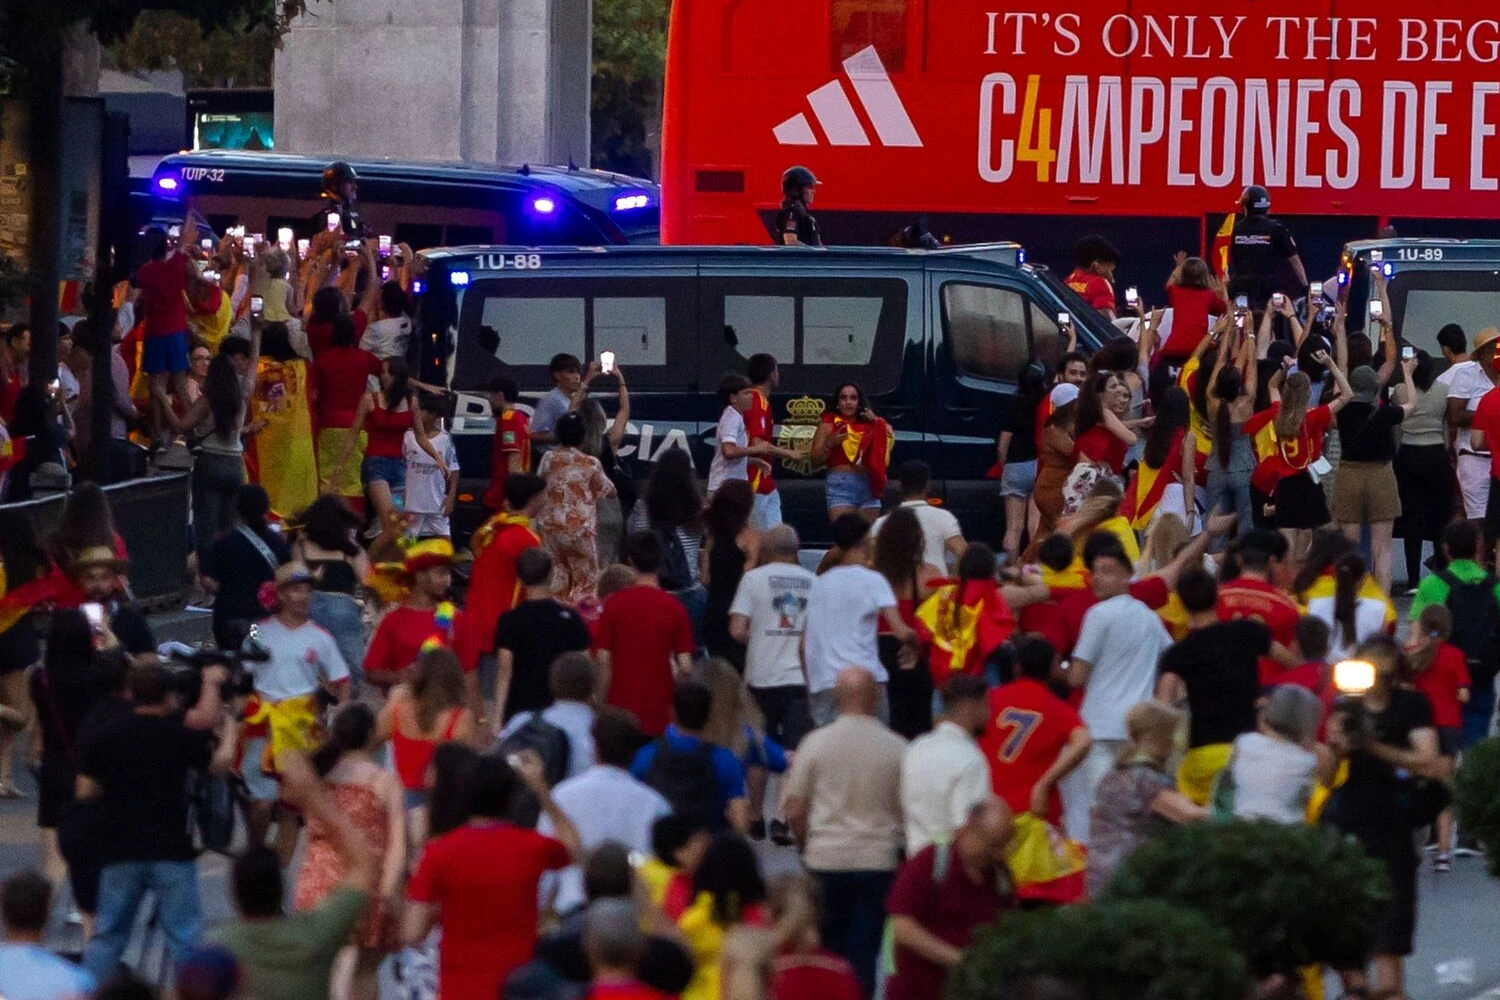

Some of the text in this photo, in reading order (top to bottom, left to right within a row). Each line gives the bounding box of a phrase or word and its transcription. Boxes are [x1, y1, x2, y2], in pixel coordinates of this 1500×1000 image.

[983, 11, 1081, 56] IT'S
[1102, 13, 1247, 60] ONLY
[1265, 16, 1378, 61] THE
[977, 71, 1362, 190] C4MPEONES
[1380, 80, 1453, 190] DE
[180, 167, 225, 182] 1UIP-32
[474, 254, 542, 270] 1U-88
[1397, 248, 1444, 261] 1U-89
[995, 706, 1044, 765] 7
